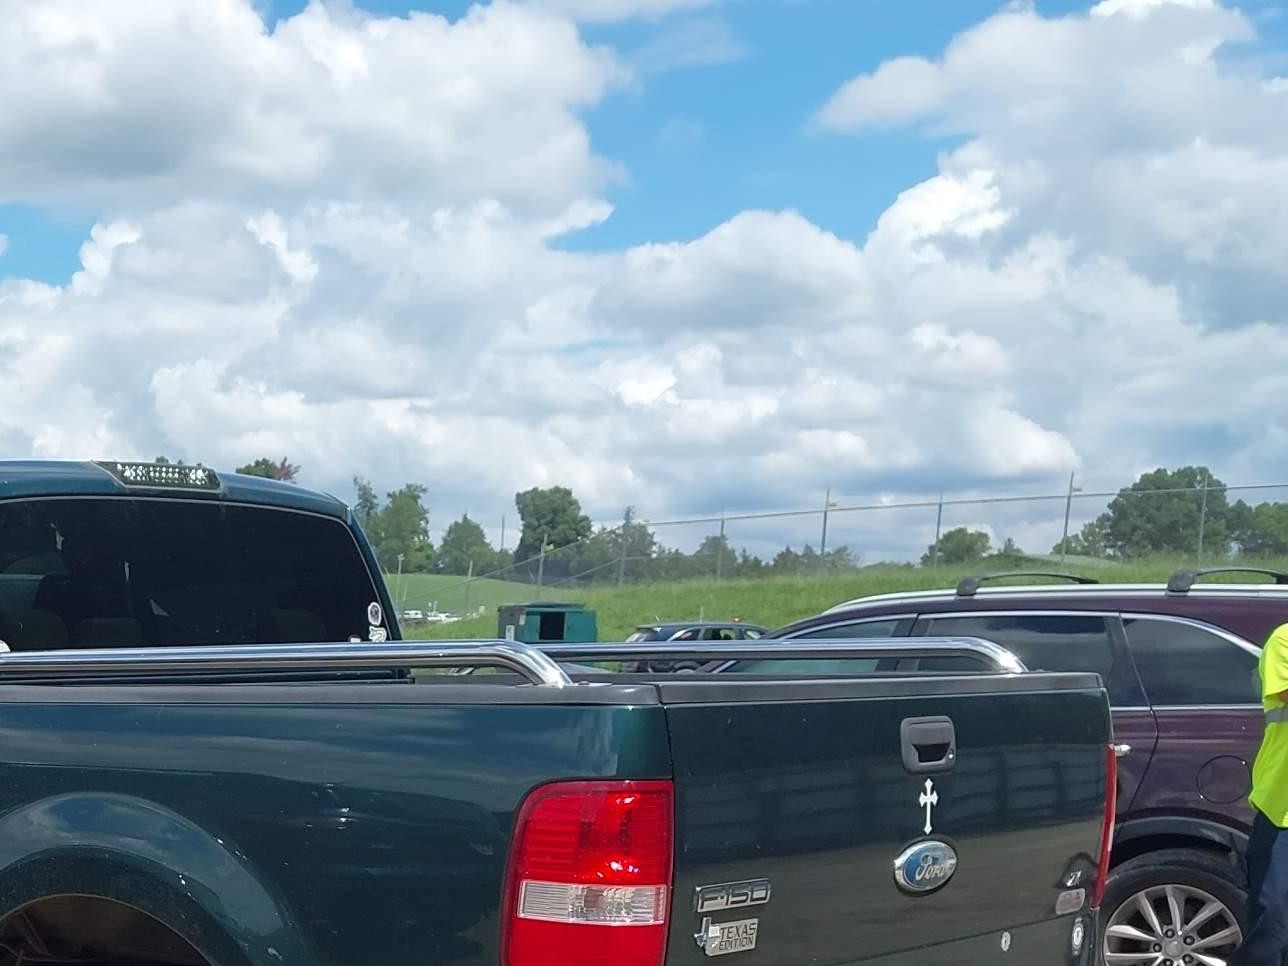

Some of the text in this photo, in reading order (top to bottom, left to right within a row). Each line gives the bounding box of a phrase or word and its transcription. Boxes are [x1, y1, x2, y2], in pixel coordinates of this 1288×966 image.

[915, 853, 945, 880] Ford
[697, 880, 770, 912] F-150
[720, 922, 757, 940] TEXAS
[719, 936, 753, 950] EDITION
